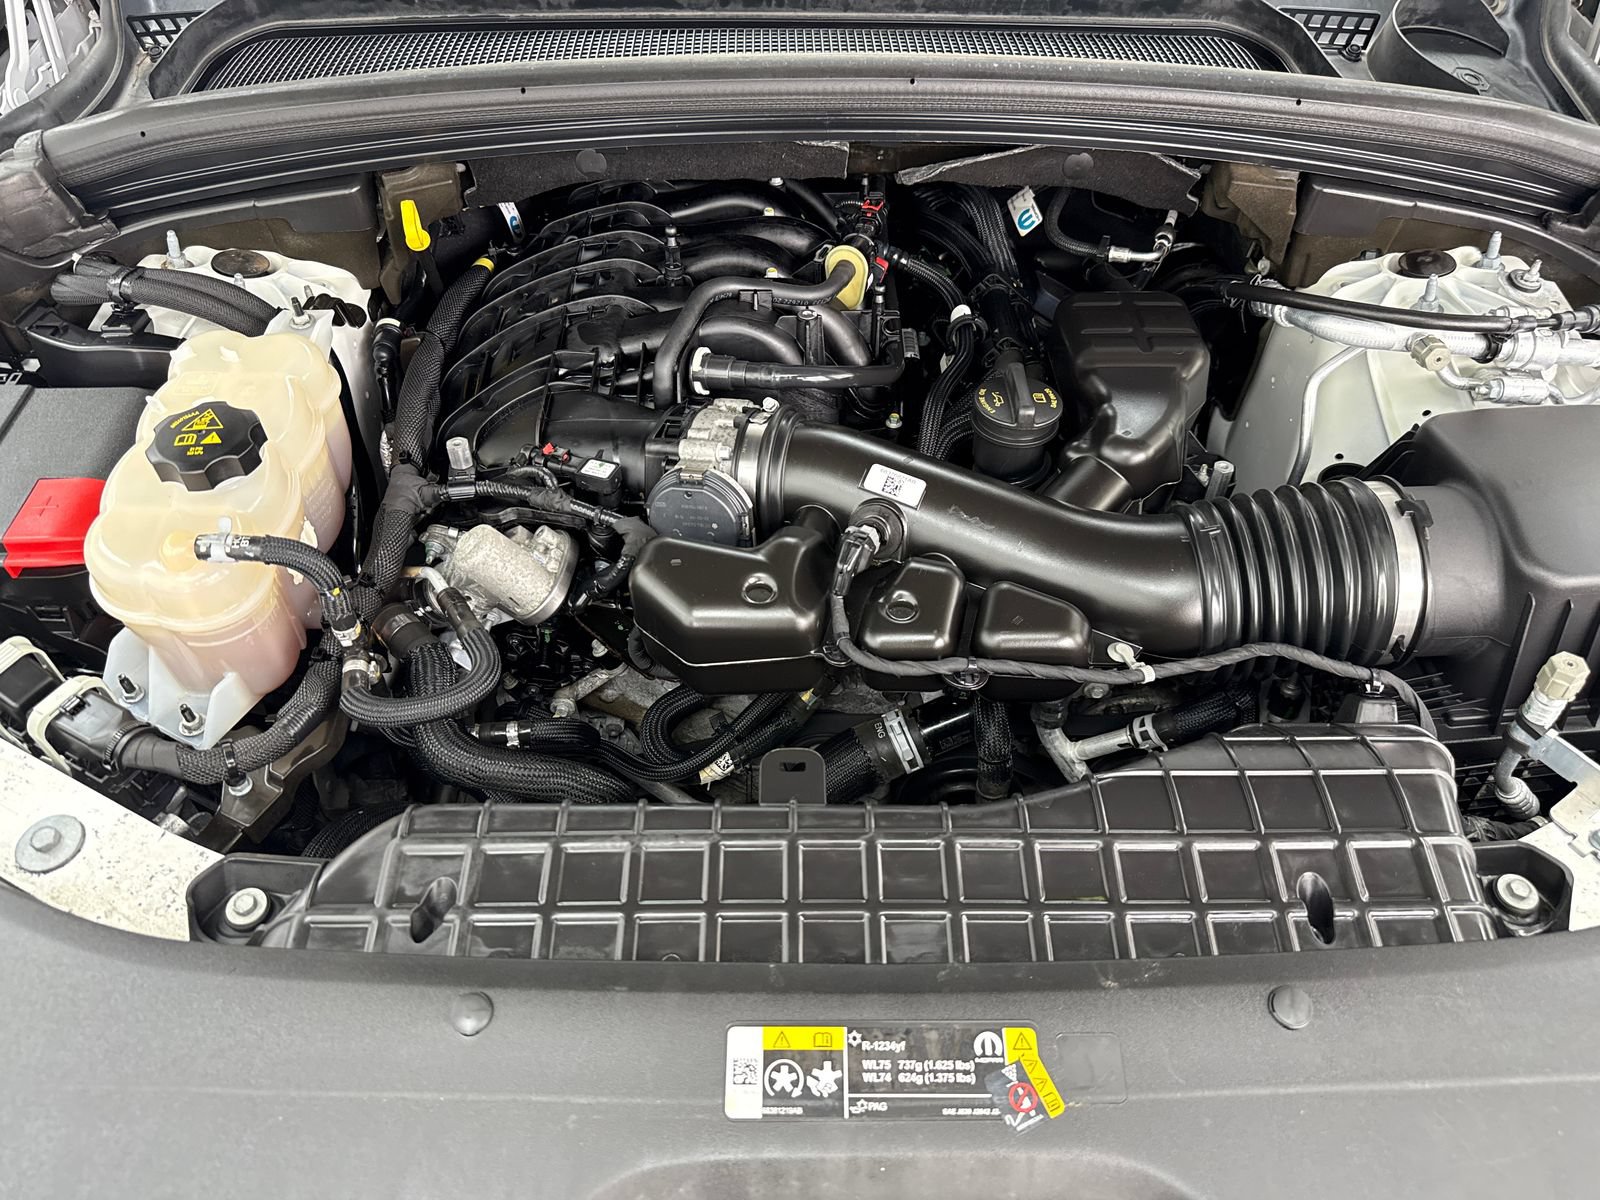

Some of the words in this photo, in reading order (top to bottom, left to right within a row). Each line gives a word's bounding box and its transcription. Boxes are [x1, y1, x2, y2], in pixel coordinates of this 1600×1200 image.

[874, 722, 886, 739] ENG
[862, 1059, 892, 1070] WL75
[897, 1059, 923, 1072] 737g
[923, 1060, 954, 1072] (1.625
[955, 1060, 976, 1072] lbs)
[862, 1072, 892, 1082] WL74
[897, 1072, 924, 1085] 624g
[924, 1073, 955, 1085] (1.375
[956, 1073, 977, 1085] lbs)
[868, 1101, 888, 1111] PAG
